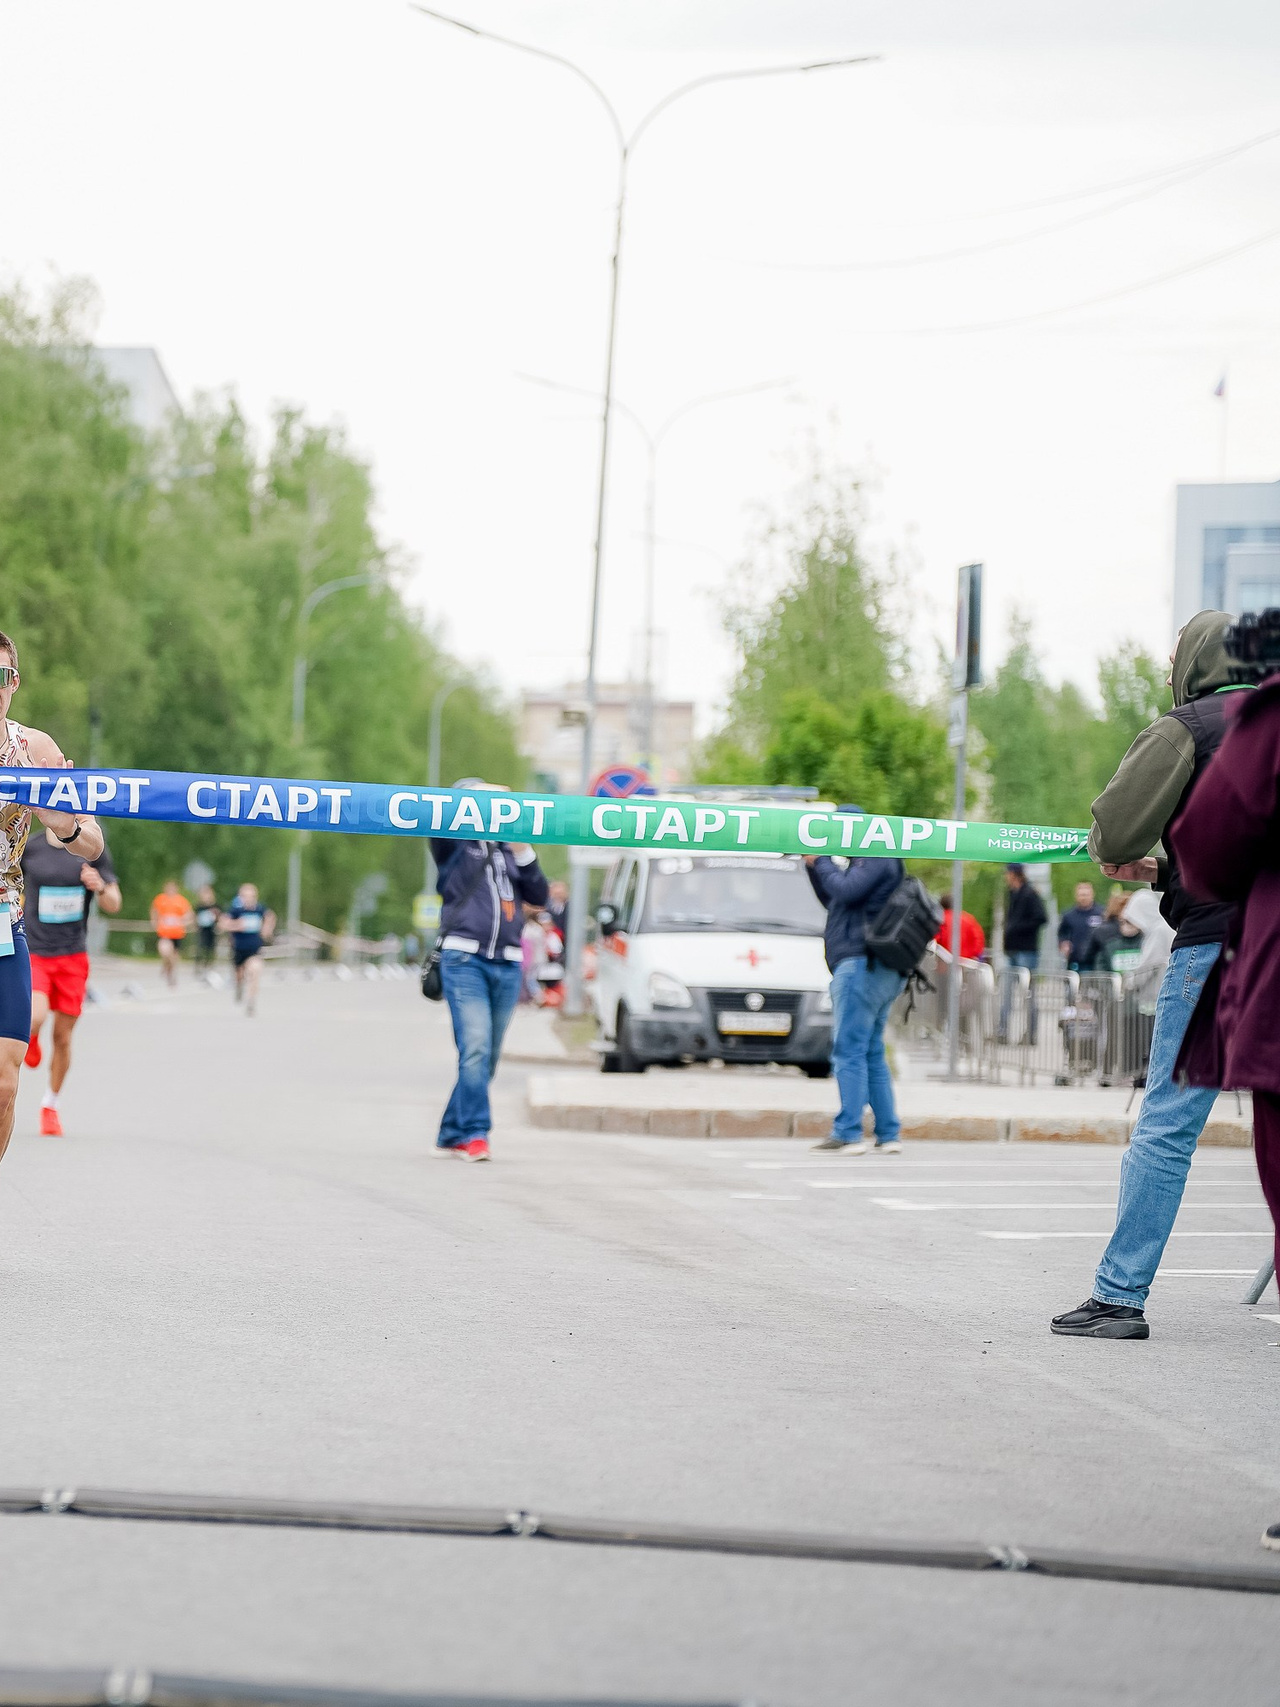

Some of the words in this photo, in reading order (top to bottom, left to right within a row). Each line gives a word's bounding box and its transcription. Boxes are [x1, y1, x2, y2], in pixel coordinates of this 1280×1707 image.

[187, 780, 352, 825] СТАРТ
[388, 791, 555, 836] СТАРТ
[591, 803, 759, 844] СТАРТ
[798, 811, 968, 853] СТАРТ
[999, 826, 1079, 843] зелёный
